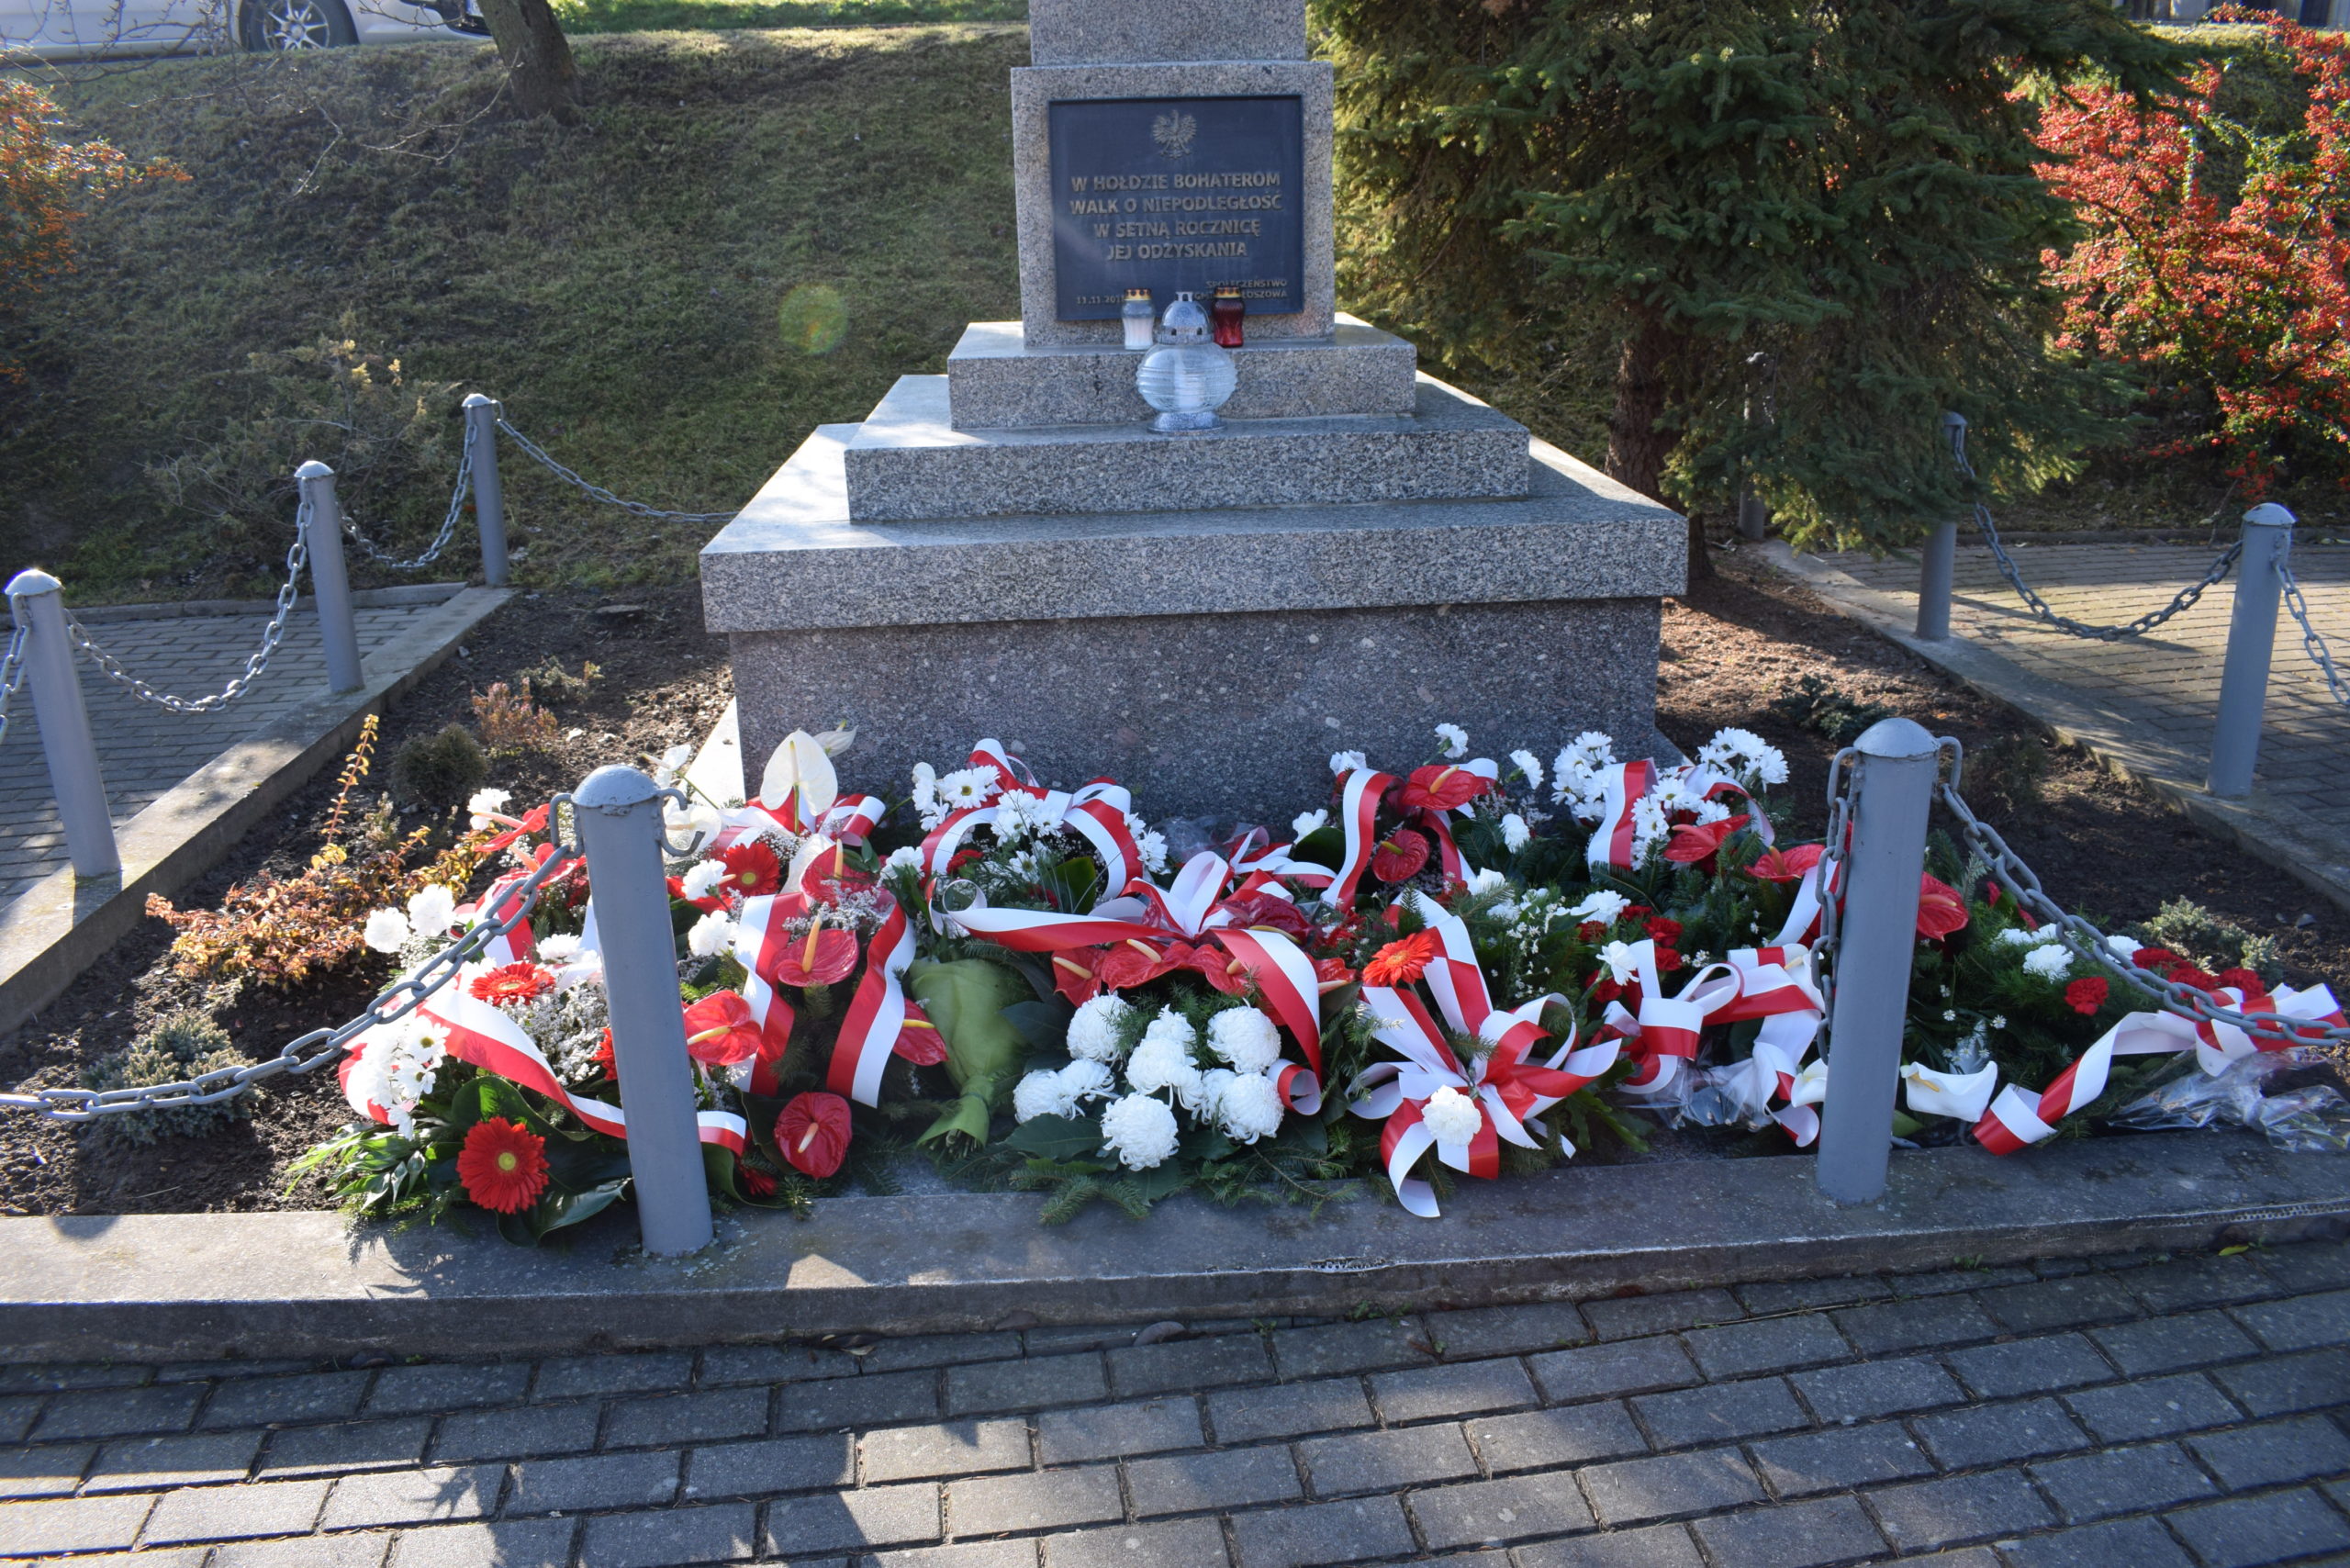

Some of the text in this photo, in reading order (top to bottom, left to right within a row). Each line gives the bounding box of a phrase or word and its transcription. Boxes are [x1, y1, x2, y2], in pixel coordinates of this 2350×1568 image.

[1070, 171, 1281, 192] W HOŁDZIE BOHATEROM
[1069, 190, 1284, 215] WALK O NIEPODLEGŁOŚĆ
[1093, 218, 1262, 240] W SETNĄ ROCZNICĘ
[1107, 241, 1248, 261] JEJ ODZYSKANIA
